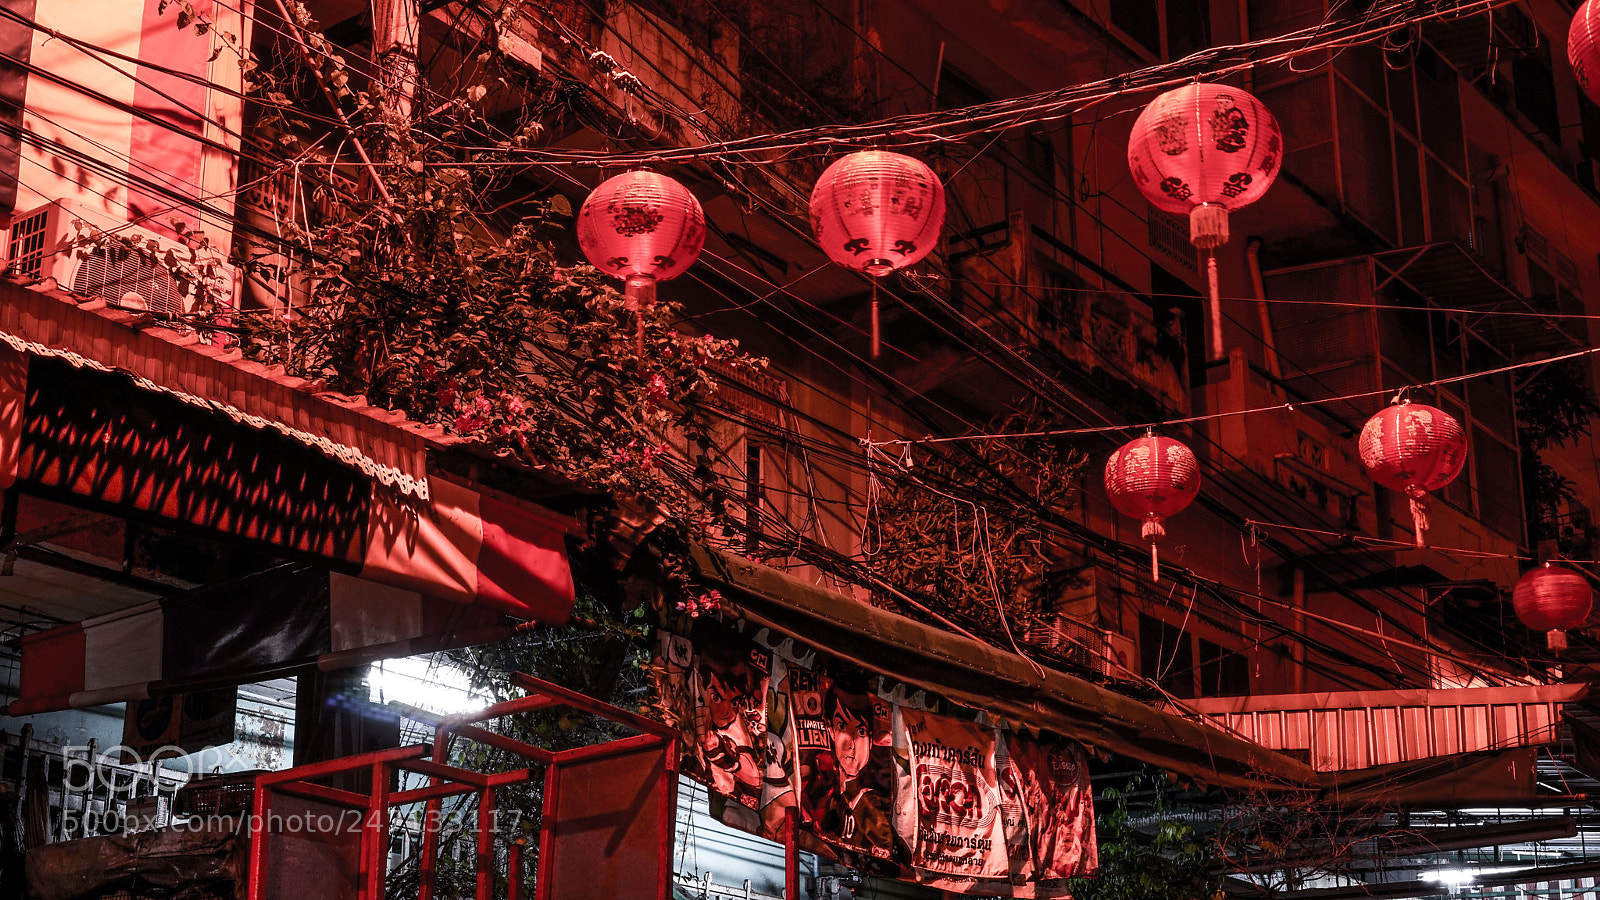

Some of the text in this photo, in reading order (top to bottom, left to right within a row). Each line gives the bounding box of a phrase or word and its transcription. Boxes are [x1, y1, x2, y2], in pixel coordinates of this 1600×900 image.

[789, 670, 819, 692] BEN
[793, 691, 823, 716] 10
[873, 703, 889, 719] CN
[841, 815, 856, 839] 10
